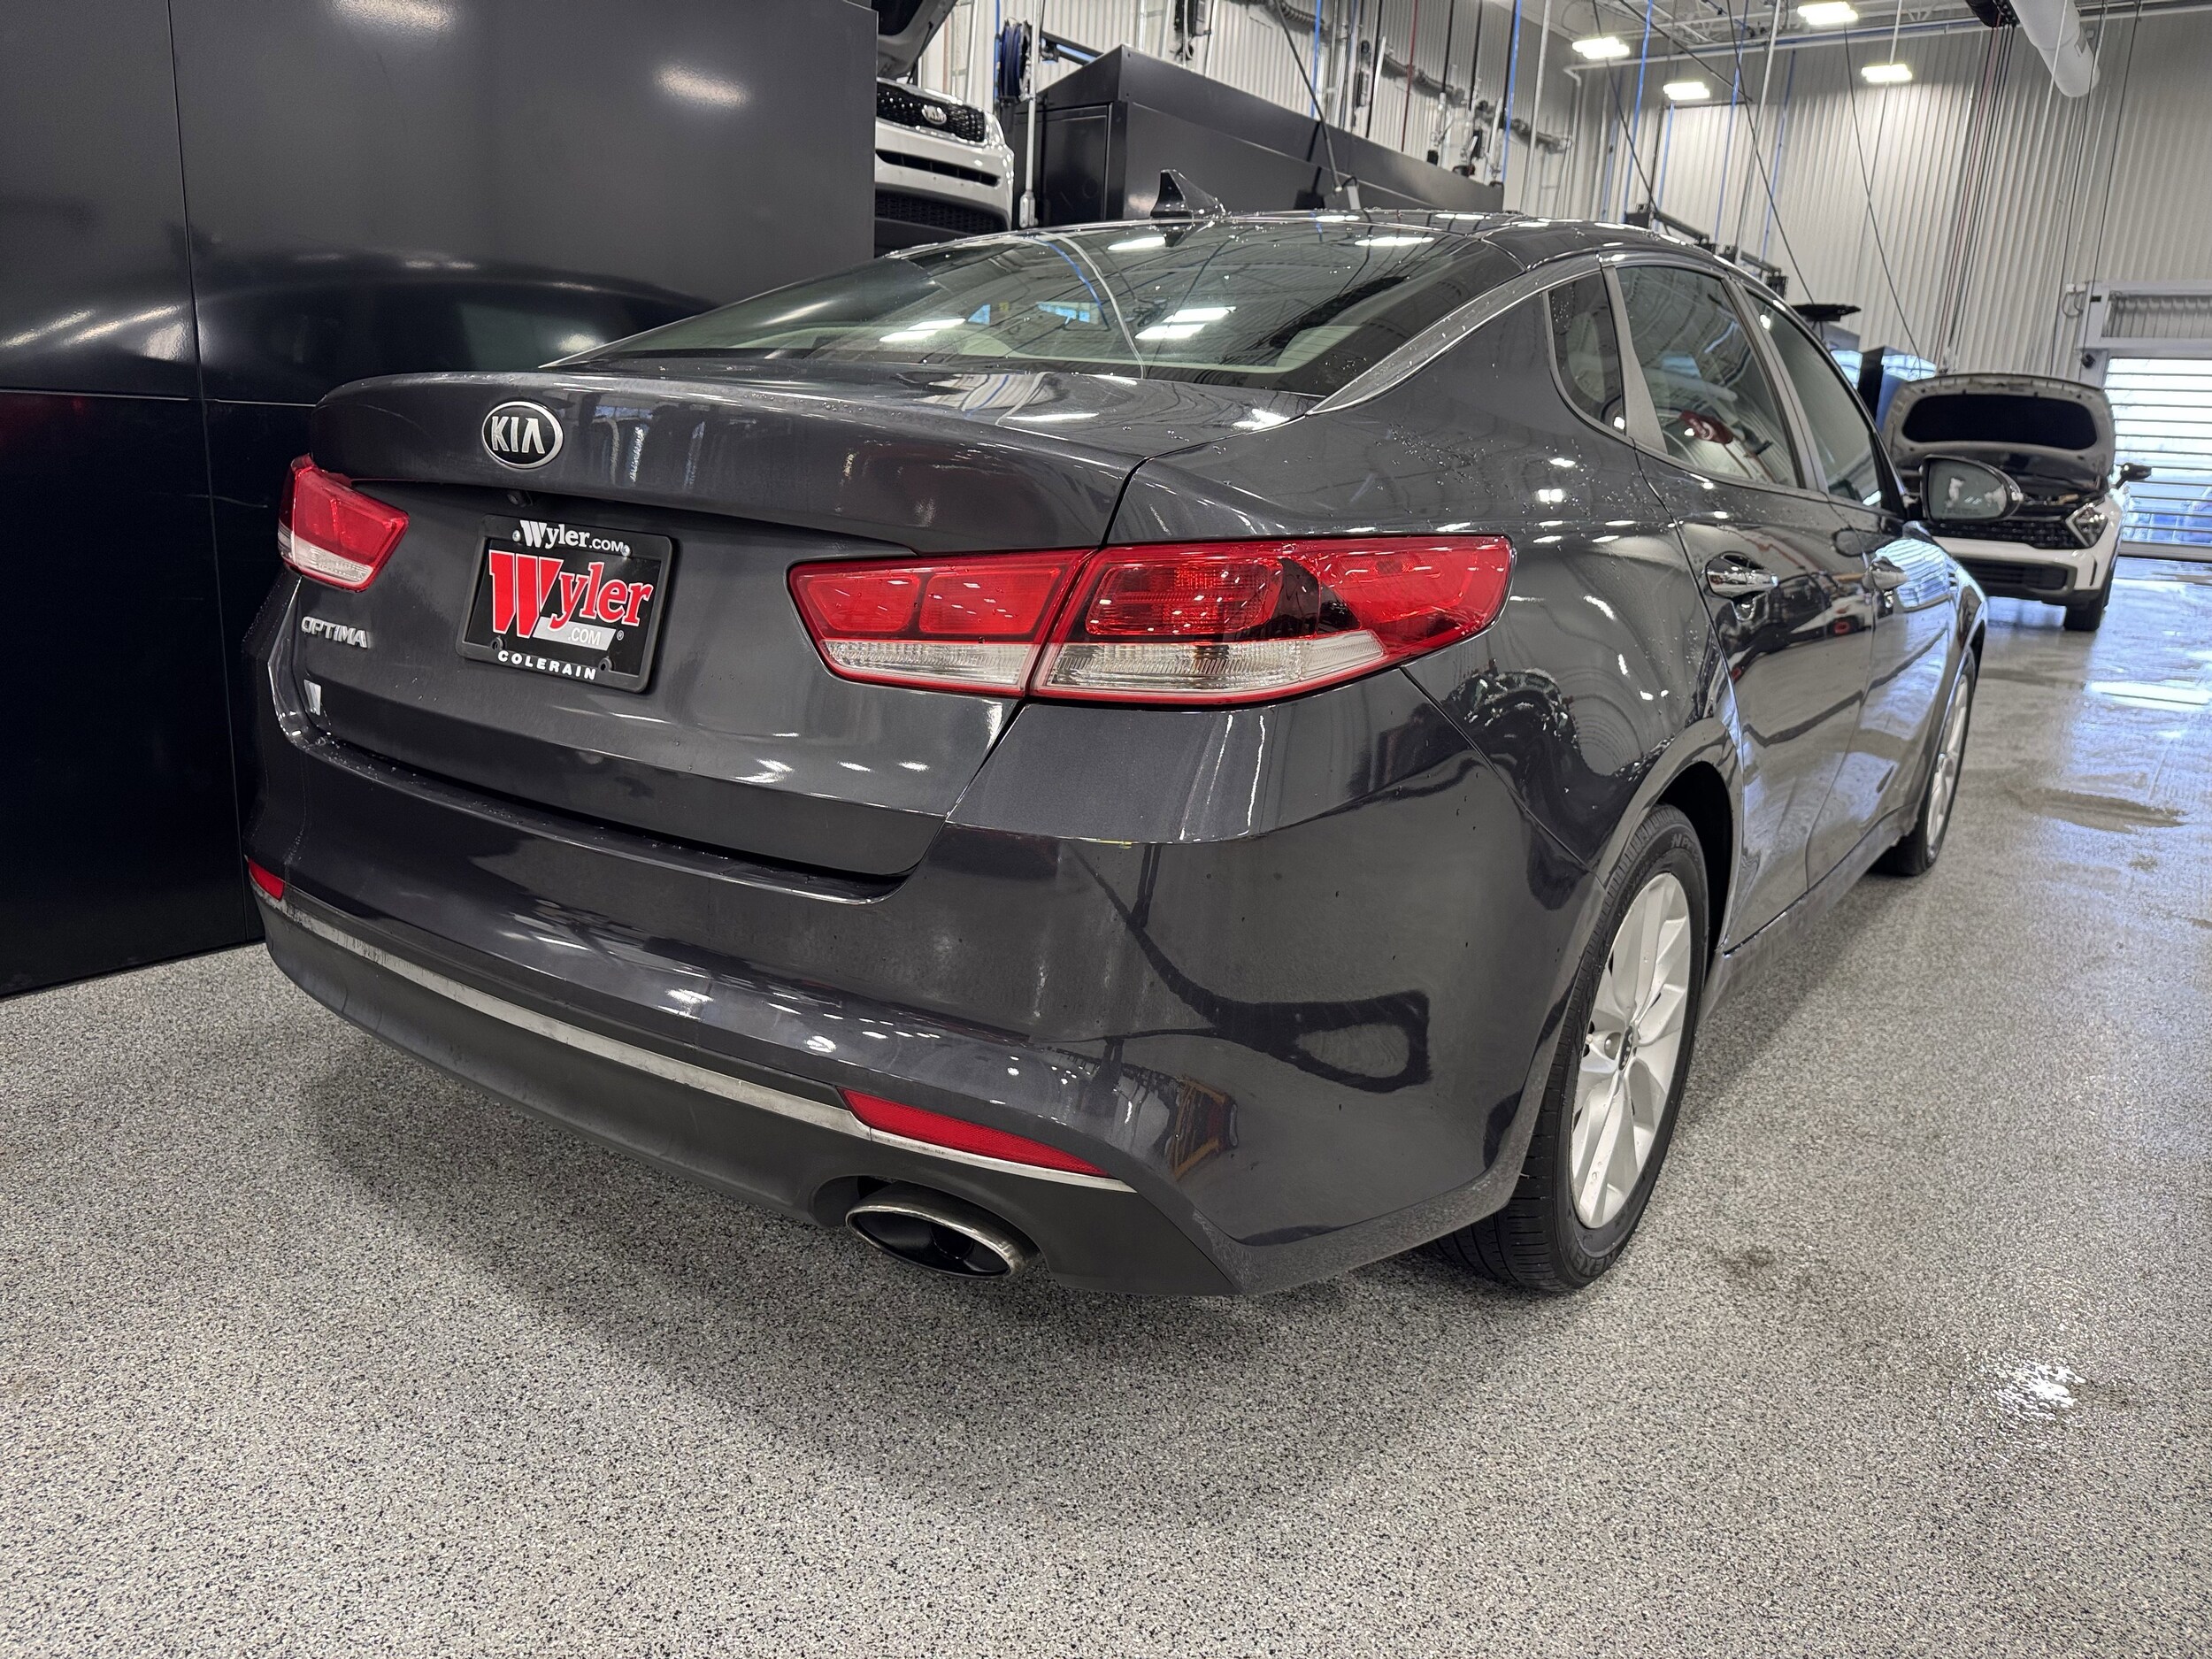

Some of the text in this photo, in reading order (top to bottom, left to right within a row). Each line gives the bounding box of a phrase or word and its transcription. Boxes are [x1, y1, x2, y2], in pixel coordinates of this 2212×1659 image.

[491, 416, 545, 454] KIA
[488, 549, 654, 638] Wyler
[301, 616, 368, 649] OPTIMA
[567, 627, 602, 646] .COM
[497, 649, 596, 680] COLERAIN
